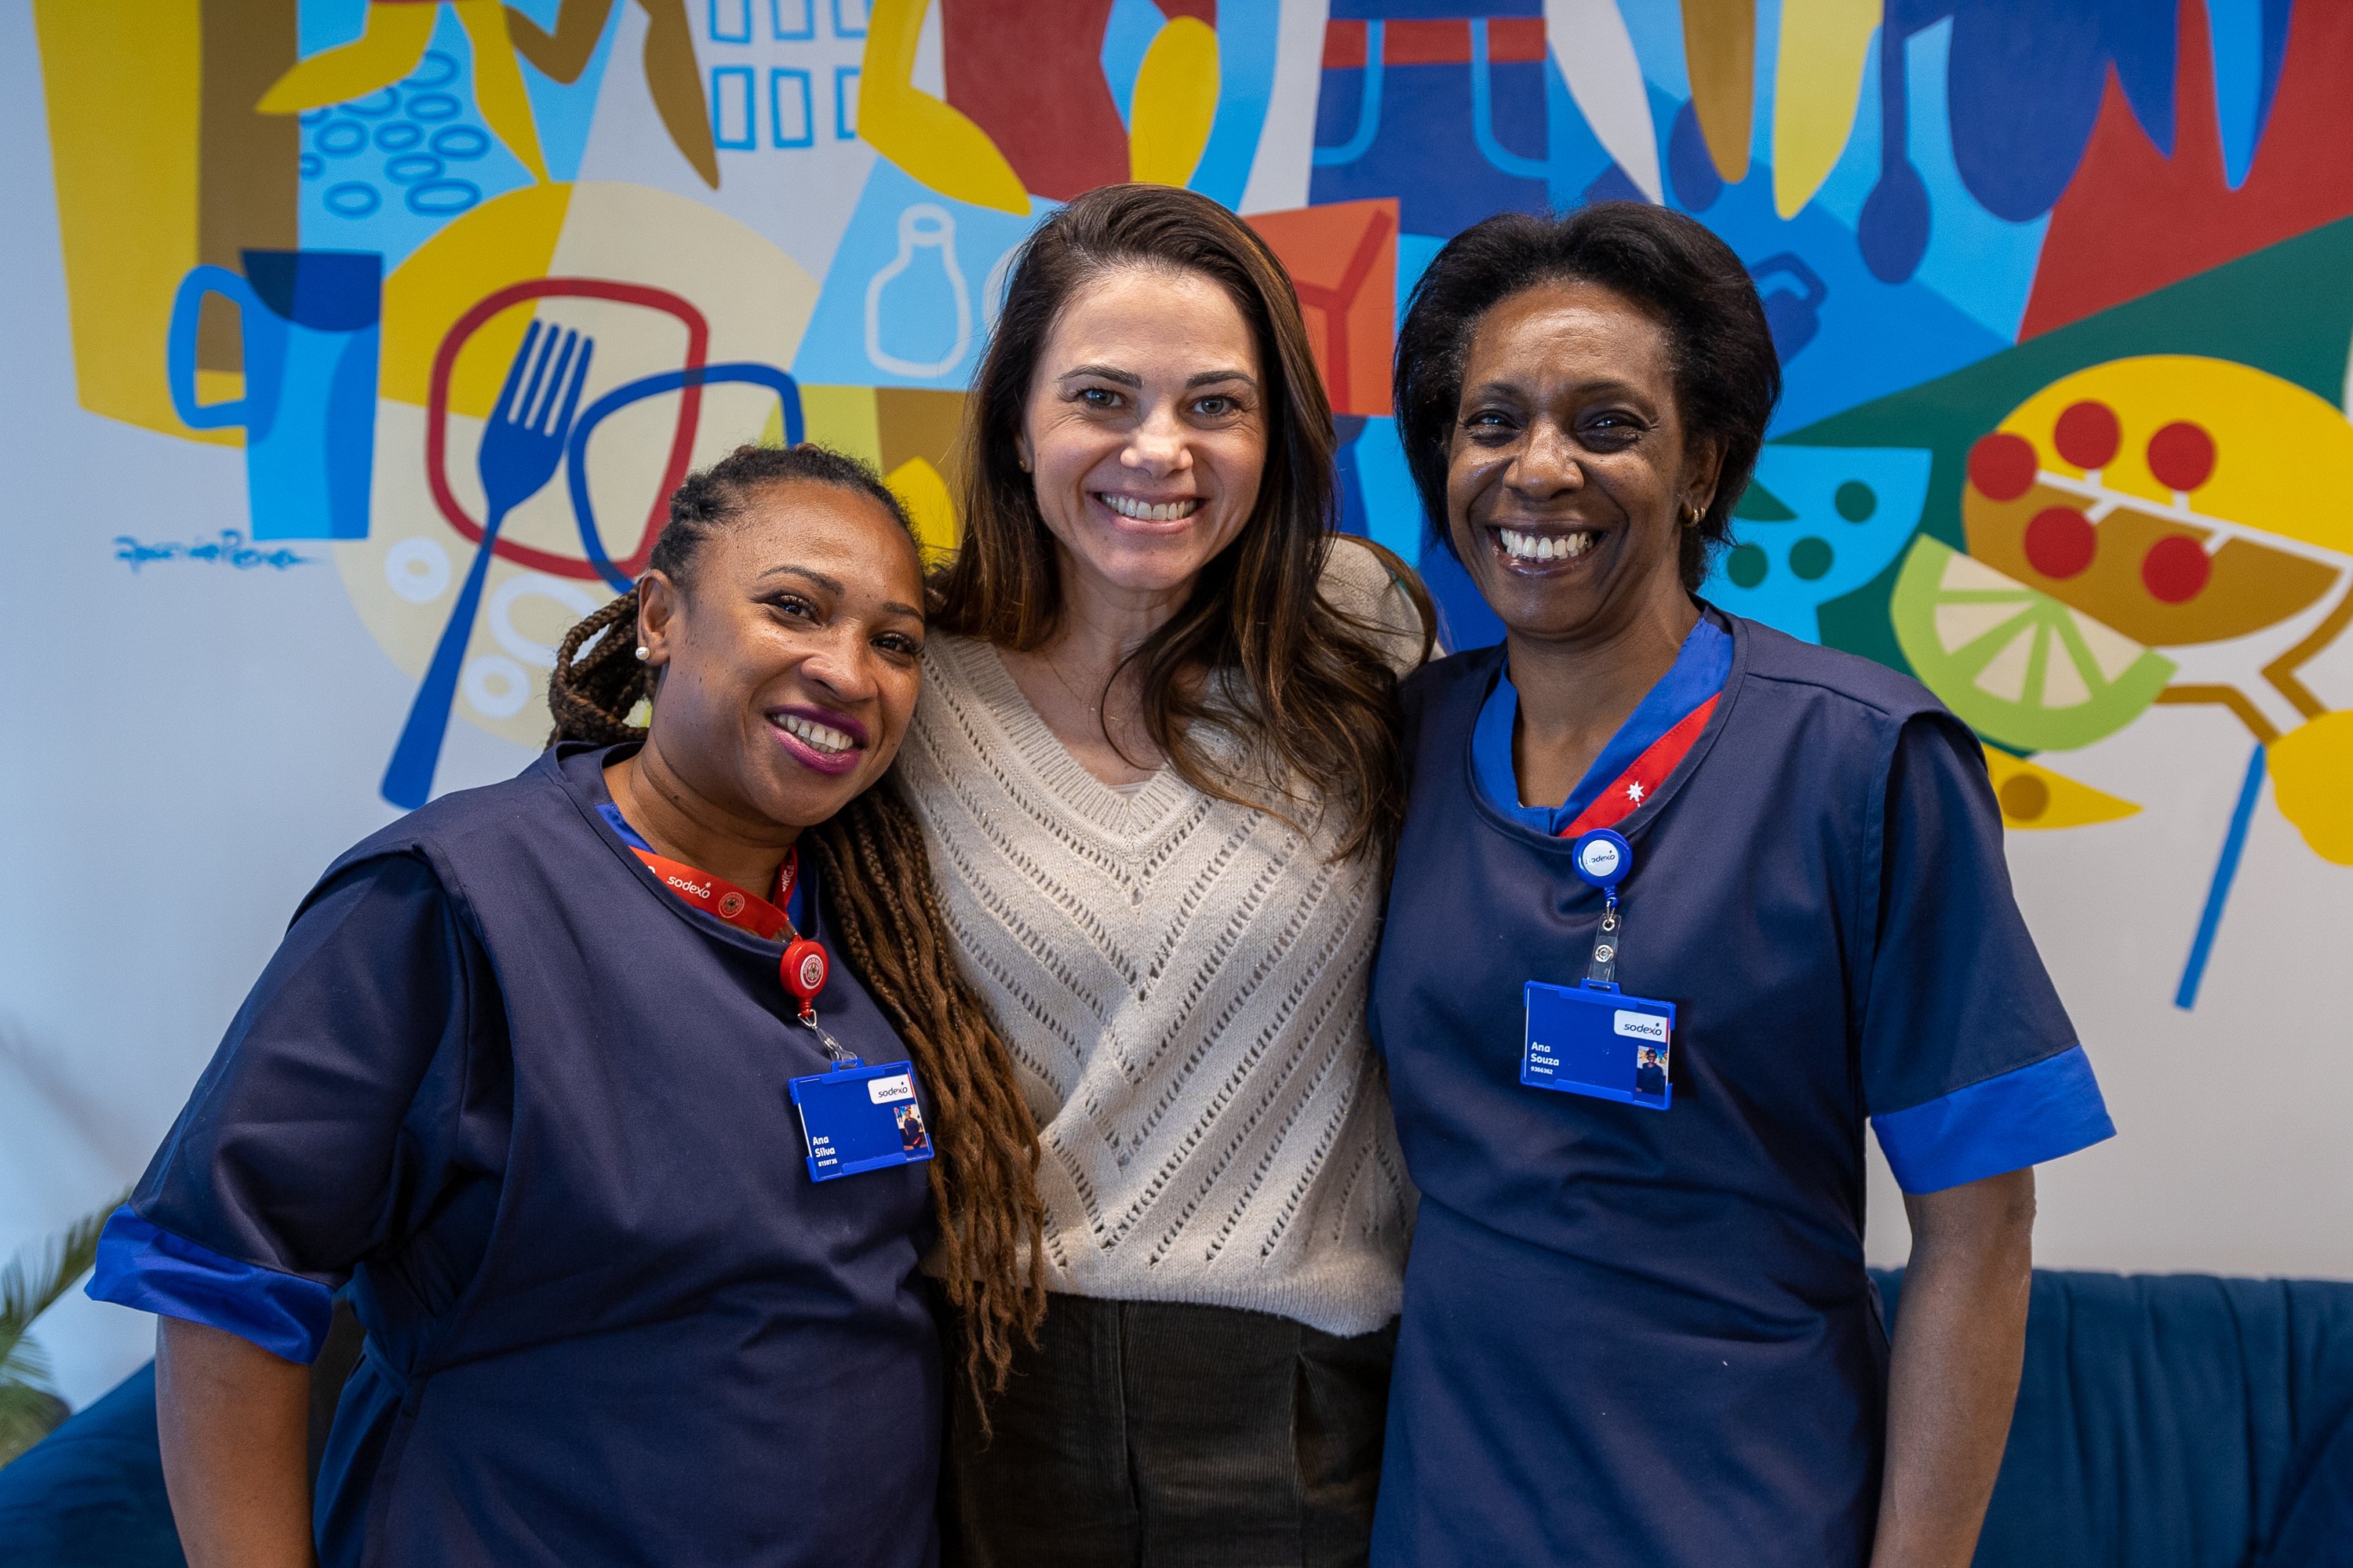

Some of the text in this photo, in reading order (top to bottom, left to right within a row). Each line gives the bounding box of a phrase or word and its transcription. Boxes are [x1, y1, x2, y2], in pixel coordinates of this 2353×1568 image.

[666, 876, 711, 899] sodexo
[1623, 1024, 1663, 1036] sodexo
[1531, 1042, 1550, 1053] Ana
[1531, 1053, 1560, 1066] Souza
[878, 1086, 908, 1098] sodexo
[813, 1136, 829, 1146] Ana
[814, 1147, 836, 1158] Silva
